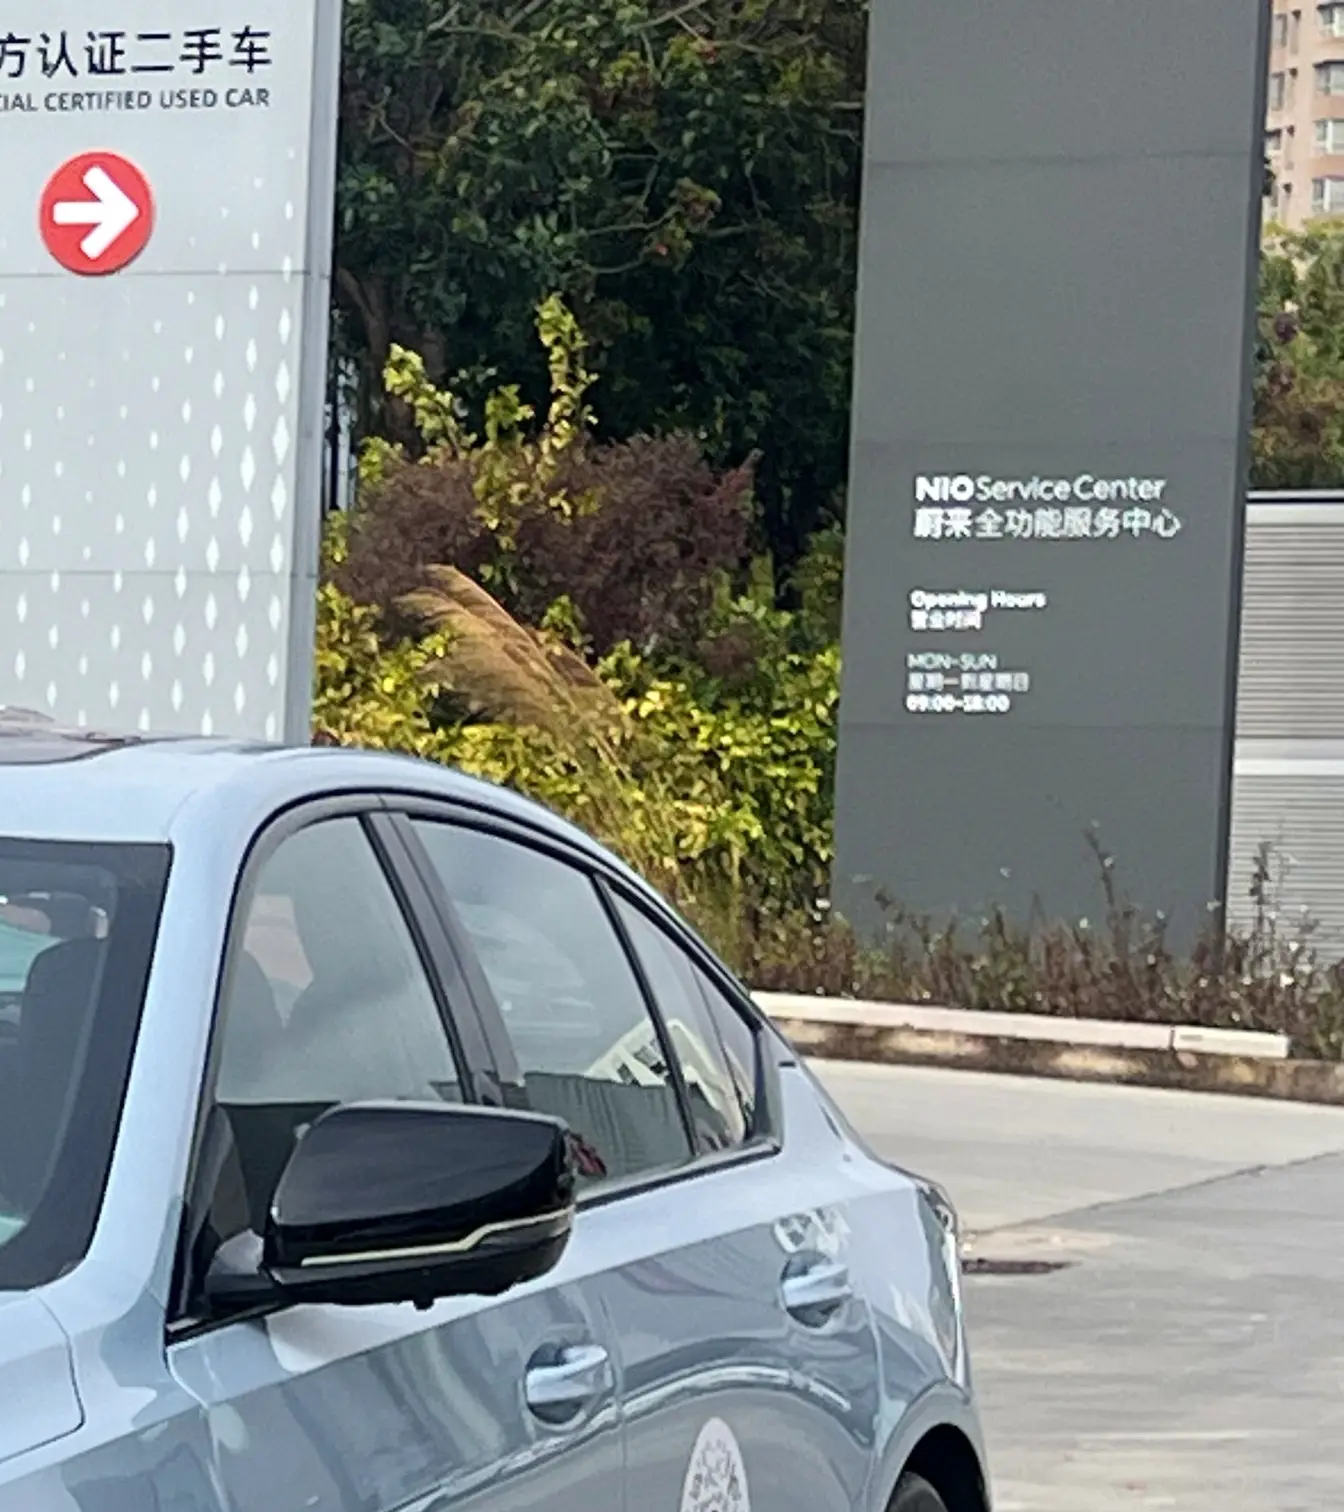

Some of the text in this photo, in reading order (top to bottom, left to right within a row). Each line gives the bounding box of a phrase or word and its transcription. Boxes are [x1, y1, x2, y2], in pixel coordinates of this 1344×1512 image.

[44, 90, 152, 112] CERTIFIED
[160, 88, 218, 109] USED
[225, 87, 270, 108] CAR
[915, 474, 1166, 501] NIO Service Center
